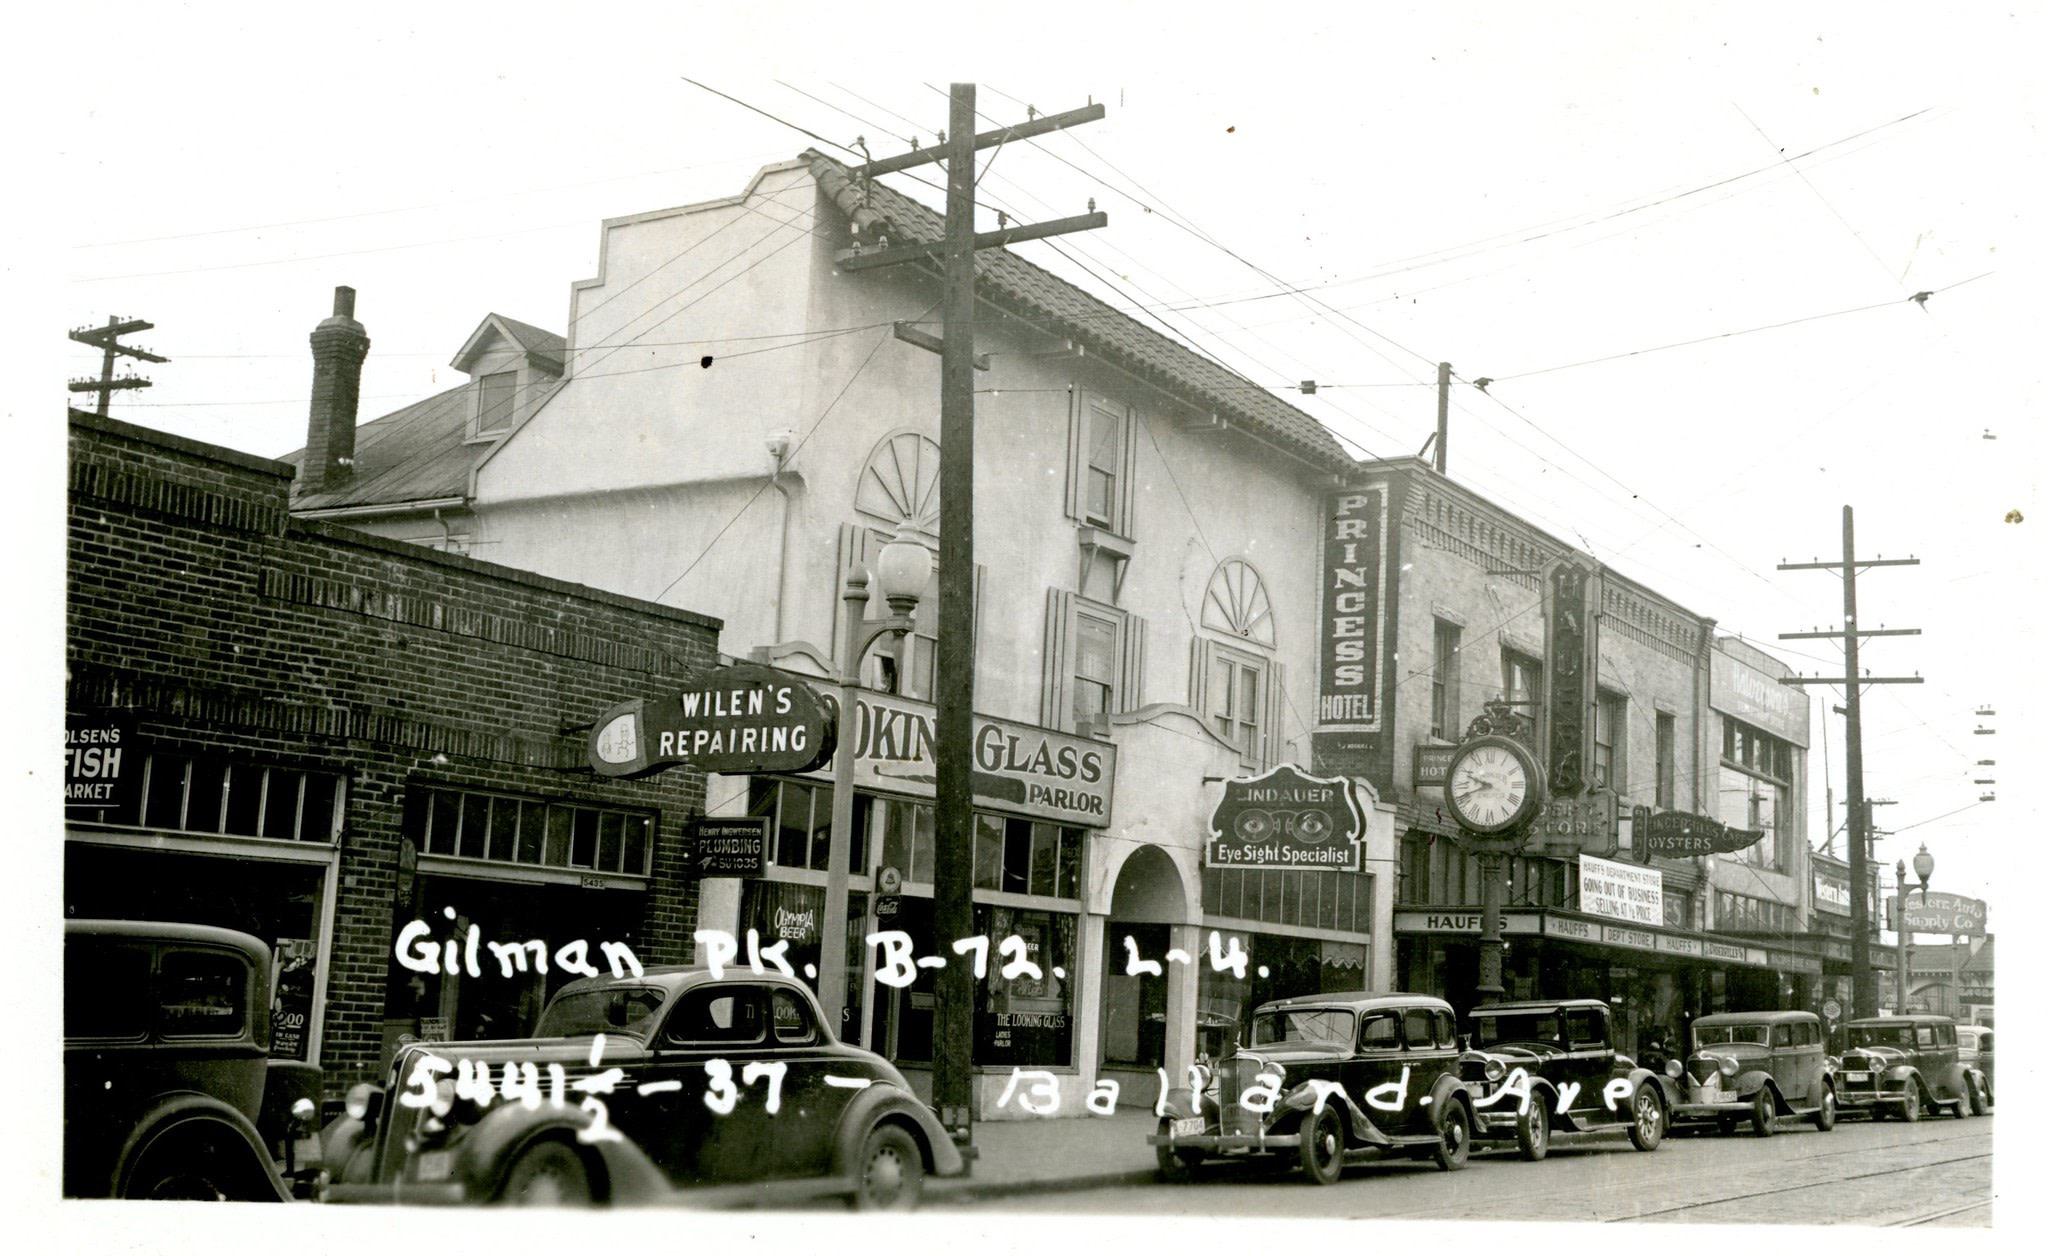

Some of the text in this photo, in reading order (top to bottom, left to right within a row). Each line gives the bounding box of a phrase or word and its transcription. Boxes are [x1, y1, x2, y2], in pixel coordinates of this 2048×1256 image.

[1333, 494, 1368, 686] PRINCESS
[683, 684, 792, 718] WILEN'S
[1321, 693, 1373, 721] HOTEL
[660, 725, 806, 757] REPAIRING
[975, 724, 1102, 783] GLASS
[1421, 766, 1447, 777] HOT
[65, 783, 114, 799] ARKET
[1029, 783, 1103, 815] PARLOR
[700, 839, 760, 854] PLUMBING
[1218, 841, 1349, 866] Eye Sight Specialist
[1648, 837, 1712, 850] OYSTERS
[1606, 865, 1641, 882] DEPARTMENT
[1642, 873, 1660, 888] STORE
[1583, 876, 1659, 905] GOING OUT OF BUSINESS
[775, 906, 815, 931] OLYMPIA
[1595, 897, 1620, 917] SELLING
[1636, 905, 1652, 921] PRICE
[1904, 911, 1949, 930] Supply
[779, 926, 807, 939] BEER
[1628, 932, 1650, 946] STORE
[997, 1014, 1065, 1028] THE LOOKING GLASS
